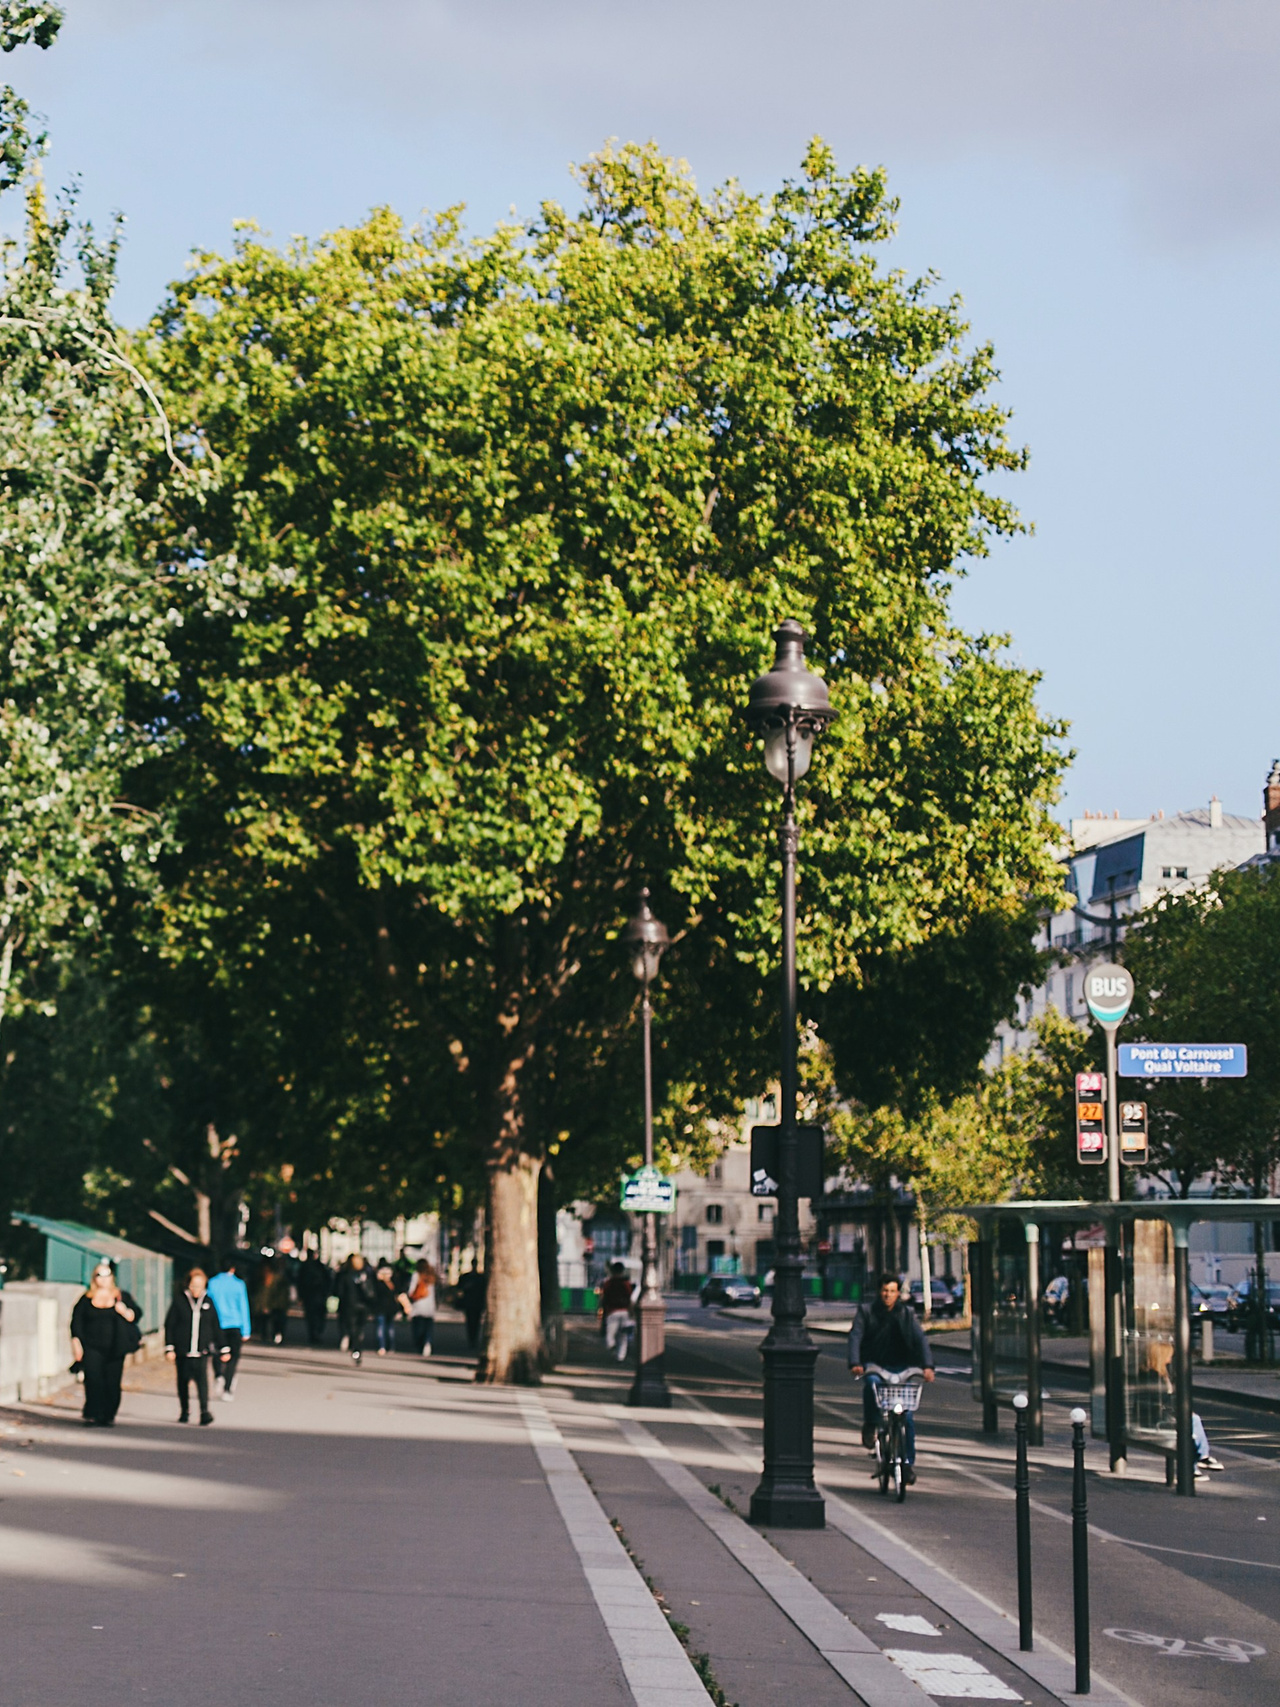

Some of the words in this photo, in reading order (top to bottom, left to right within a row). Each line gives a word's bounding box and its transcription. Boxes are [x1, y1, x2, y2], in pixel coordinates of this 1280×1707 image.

[1091, 977, 1127, 997] BUS
[1131, 1048, 1159, 1060] Pont
[1161, 1048, 1176, 1060] du
[1178, 1048, 1234, 1060] Carrousel
[1144, 1061, 1172, 1074] Quai
[1174, 1061, 1221, 1073] Voltaire
[1080, 1075, 1100, 1090] 24
[1083, 1105, 1098, 1117] 27
[1123, 1104, 1143, 1119] 95
[1082, 1133, 1101, 1149] 39
